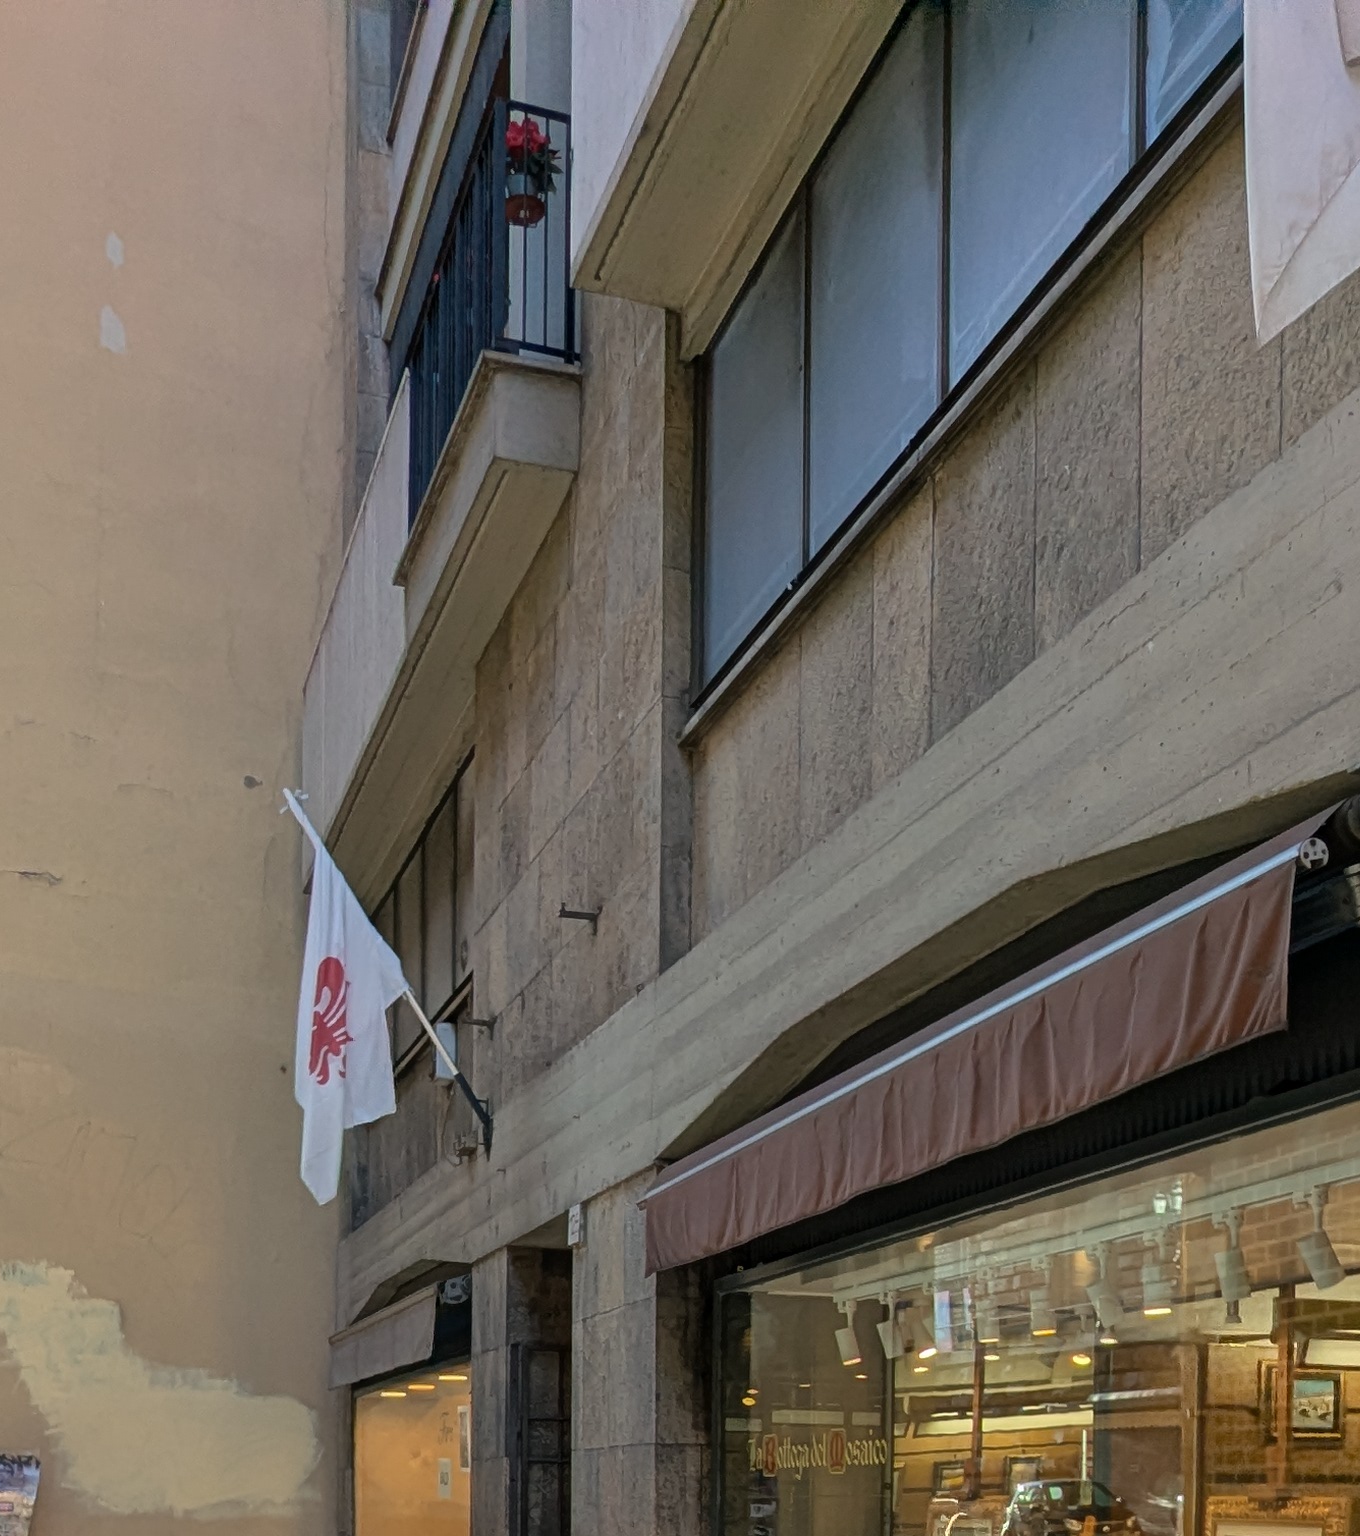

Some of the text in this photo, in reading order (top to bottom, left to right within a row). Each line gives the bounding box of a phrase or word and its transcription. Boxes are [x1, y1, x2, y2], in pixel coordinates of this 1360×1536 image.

[747, 1428, 887, 1480] La Bottega del Mosaico
